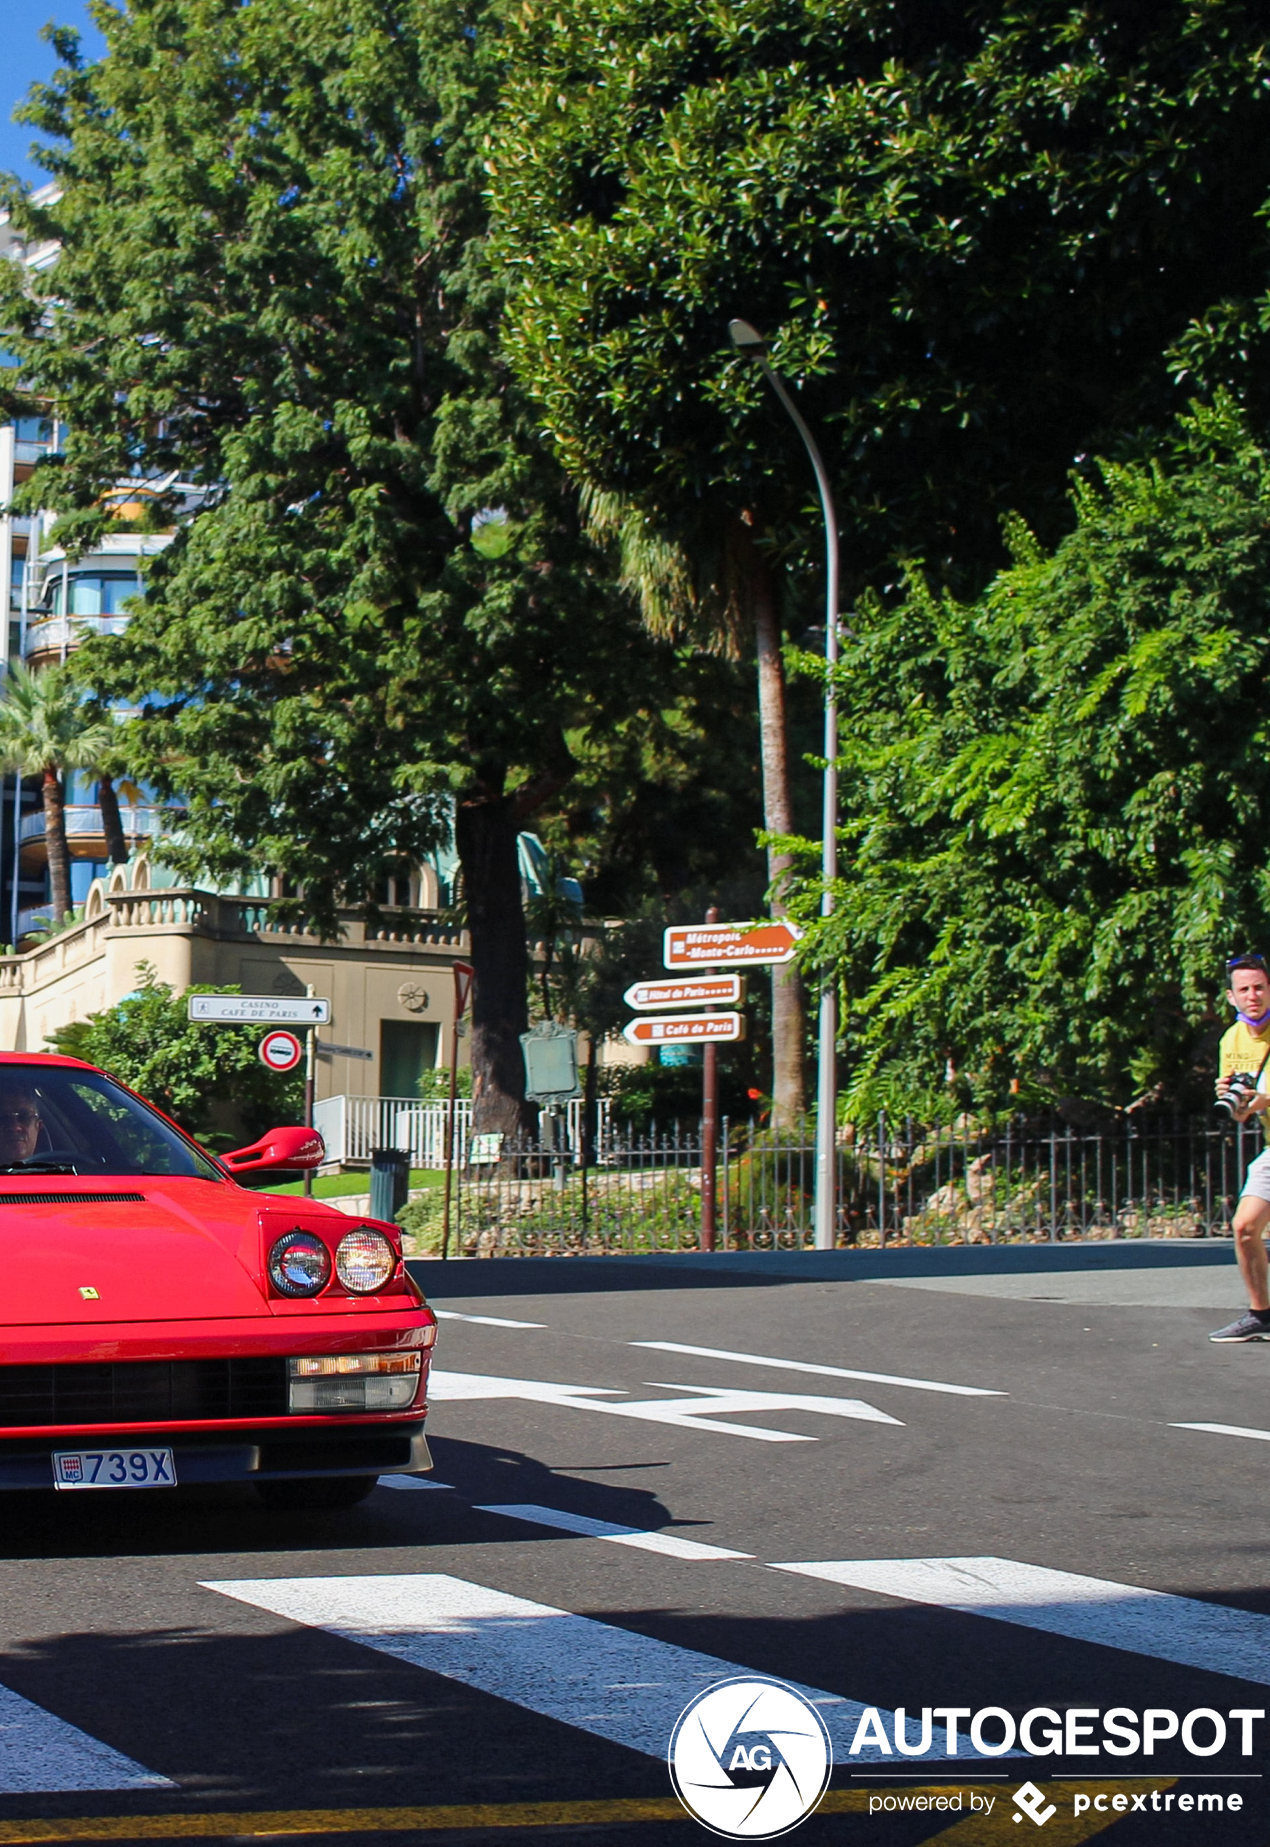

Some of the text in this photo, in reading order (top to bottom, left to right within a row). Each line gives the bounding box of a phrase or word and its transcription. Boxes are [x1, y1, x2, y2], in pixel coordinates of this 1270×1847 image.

[672, 988, 683, 999] de
[684, 986, 705, 997] Paris
[240, 1001, 279, 1010] CASINO
[220, 1009, 298, 1018] CAFE DE PARIS
[666, 1021, 733, 1036] Café de Paris
[86, 1453, 170, 1483] 739X
[65, 1470, 80, 1479] MC
